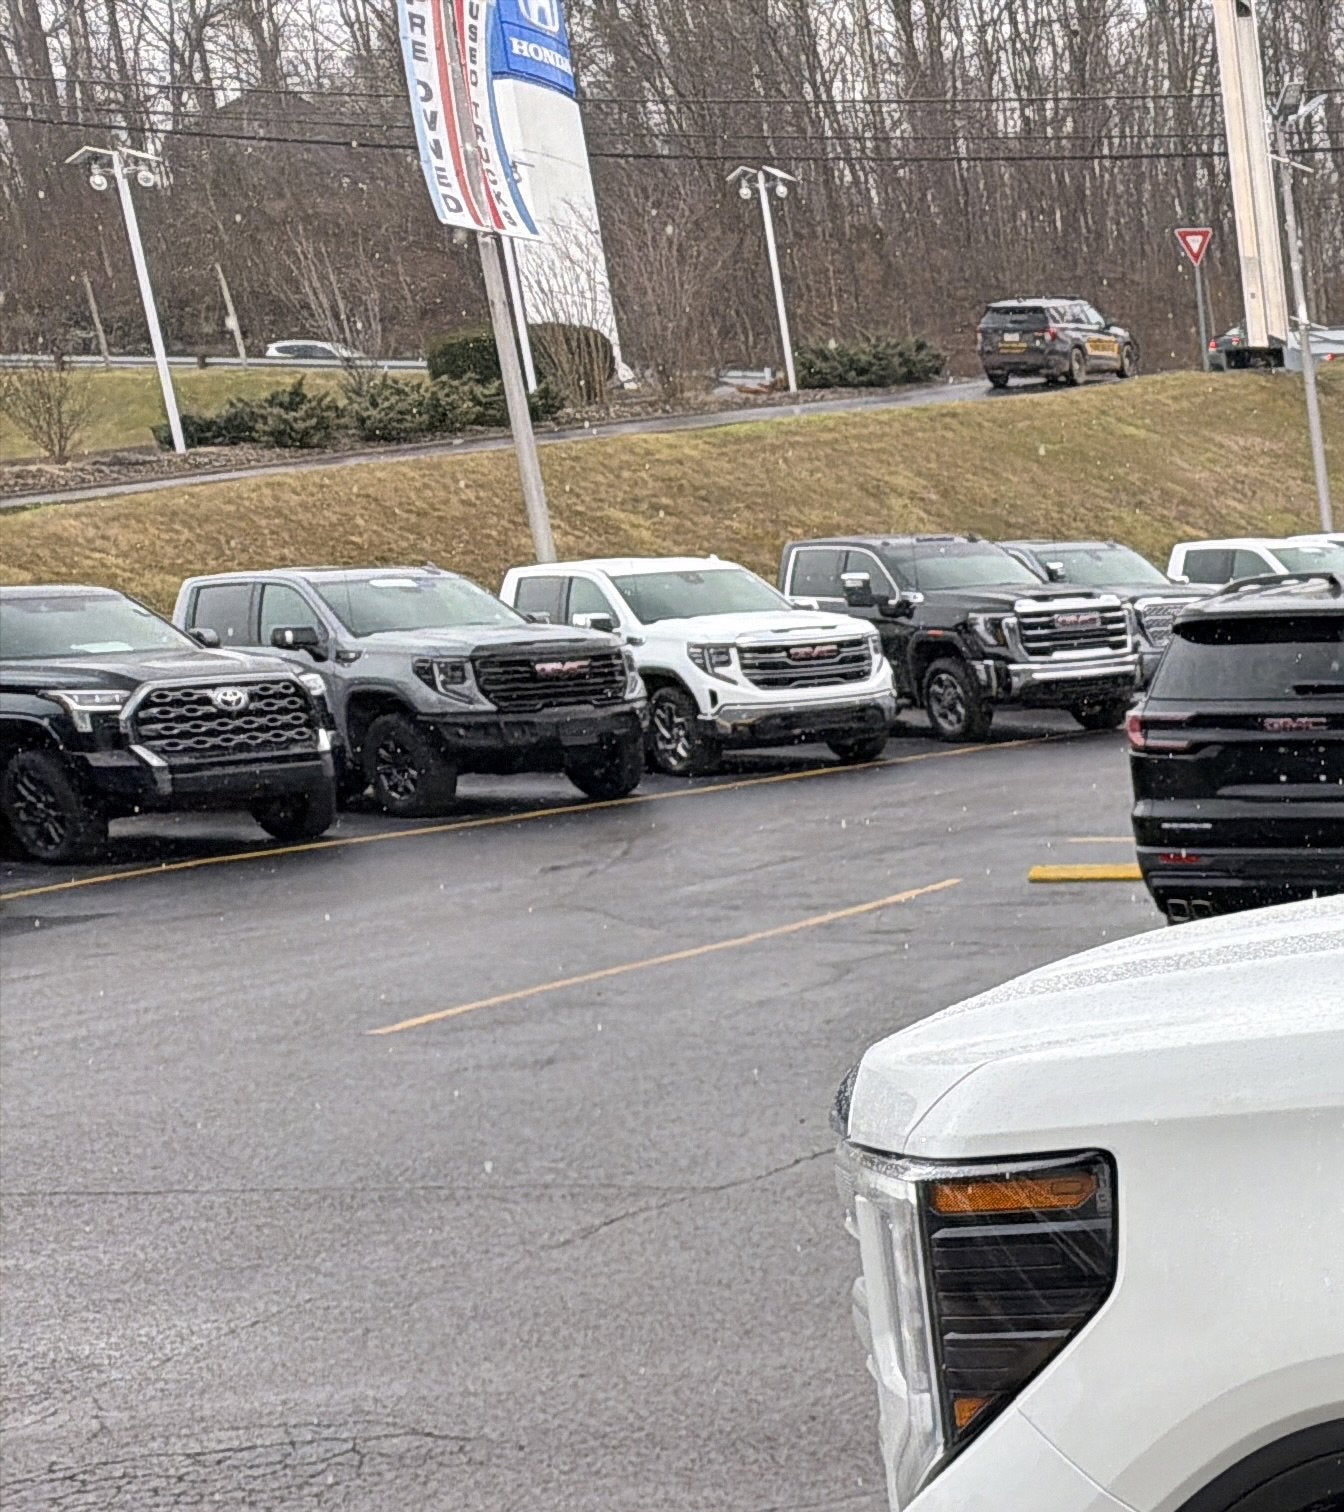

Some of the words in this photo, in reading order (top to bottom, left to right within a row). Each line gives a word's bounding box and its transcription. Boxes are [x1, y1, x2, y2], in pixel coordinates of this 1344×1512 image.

[406, 0, 428, 62] RE
[468, 1, 480, 87] USED
[789, 644, 838, 659] GMC
[1263, 716, 1328, 731] GMC
